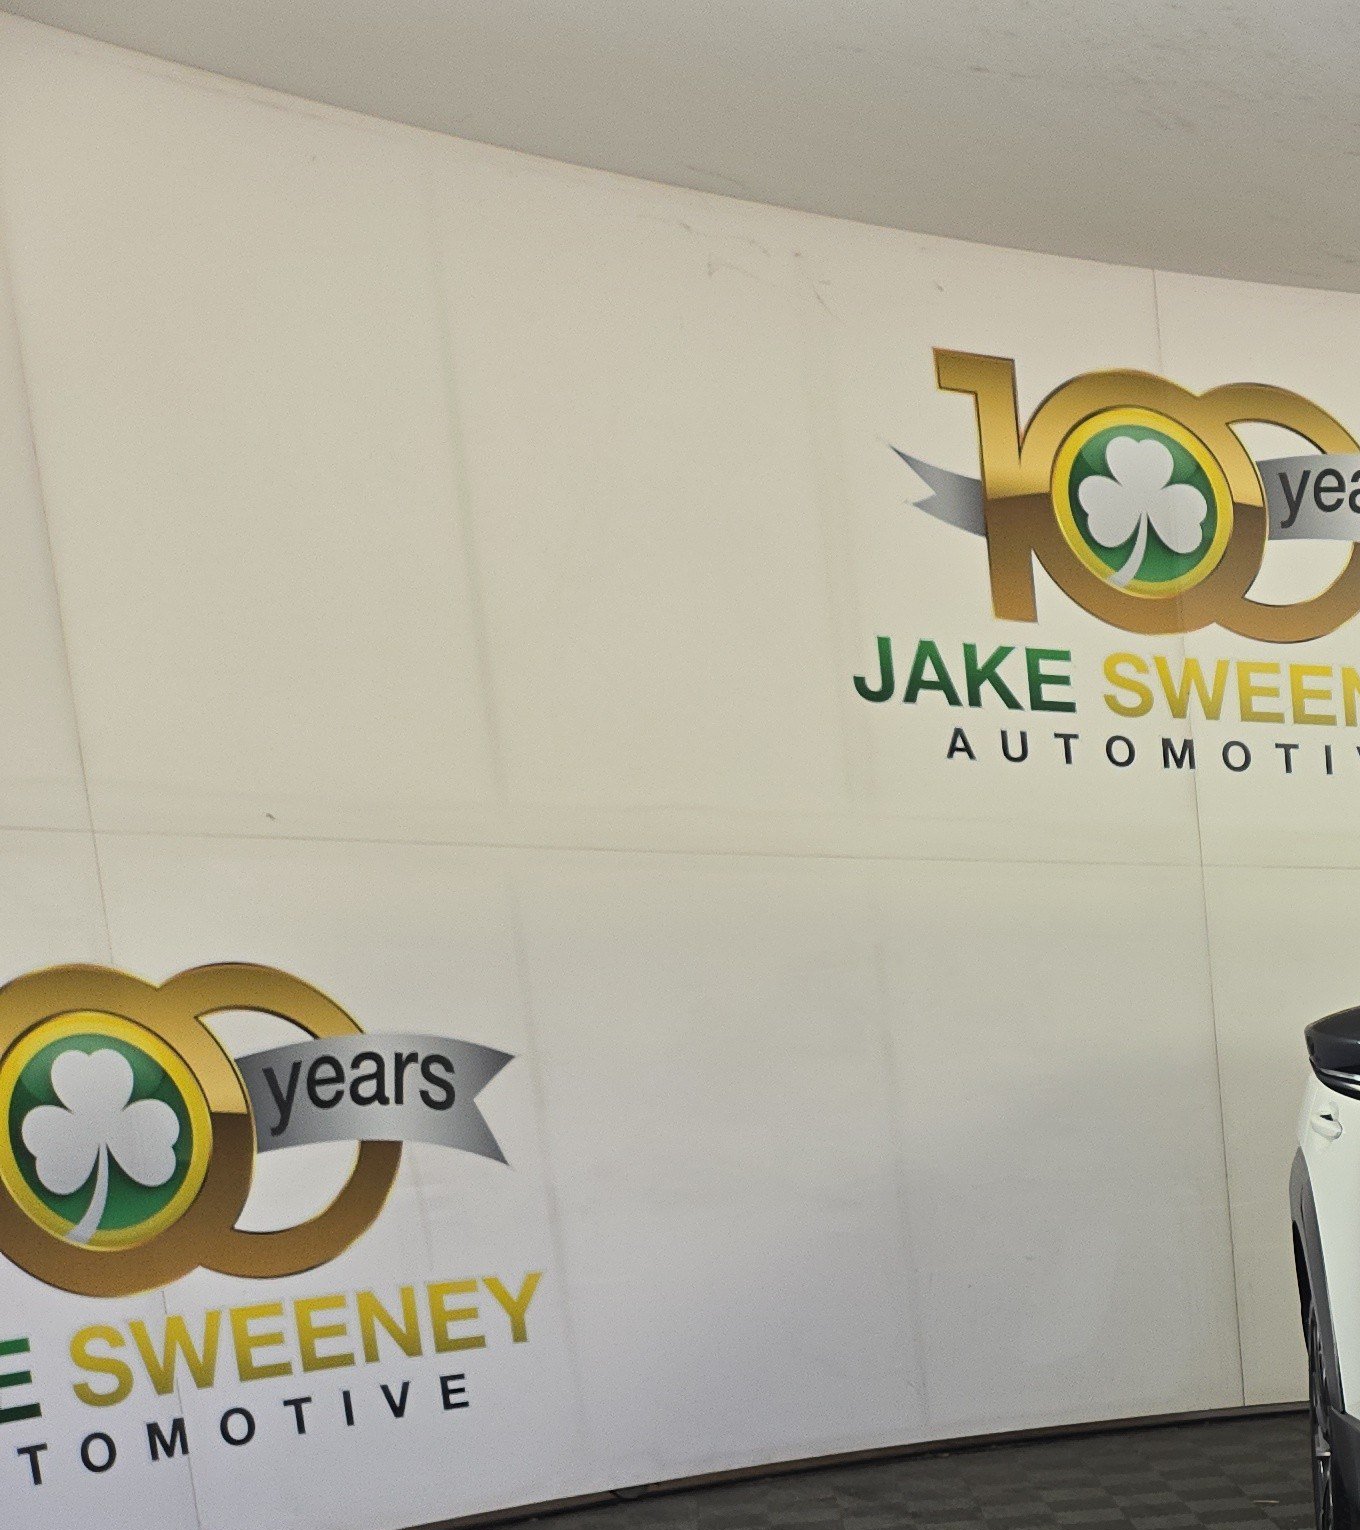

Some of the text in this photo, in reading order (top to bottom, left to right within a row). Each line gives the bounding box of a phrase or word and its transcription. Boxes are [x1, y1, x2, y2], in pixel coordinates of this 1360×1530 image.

[853, 636, 1077, 712] JAKE
[262, 1048, 456, 1137] years
[69, 1272, 542, 1408] SWEENEY
[17, 1373, 469, 1485] TOMOTIVE
